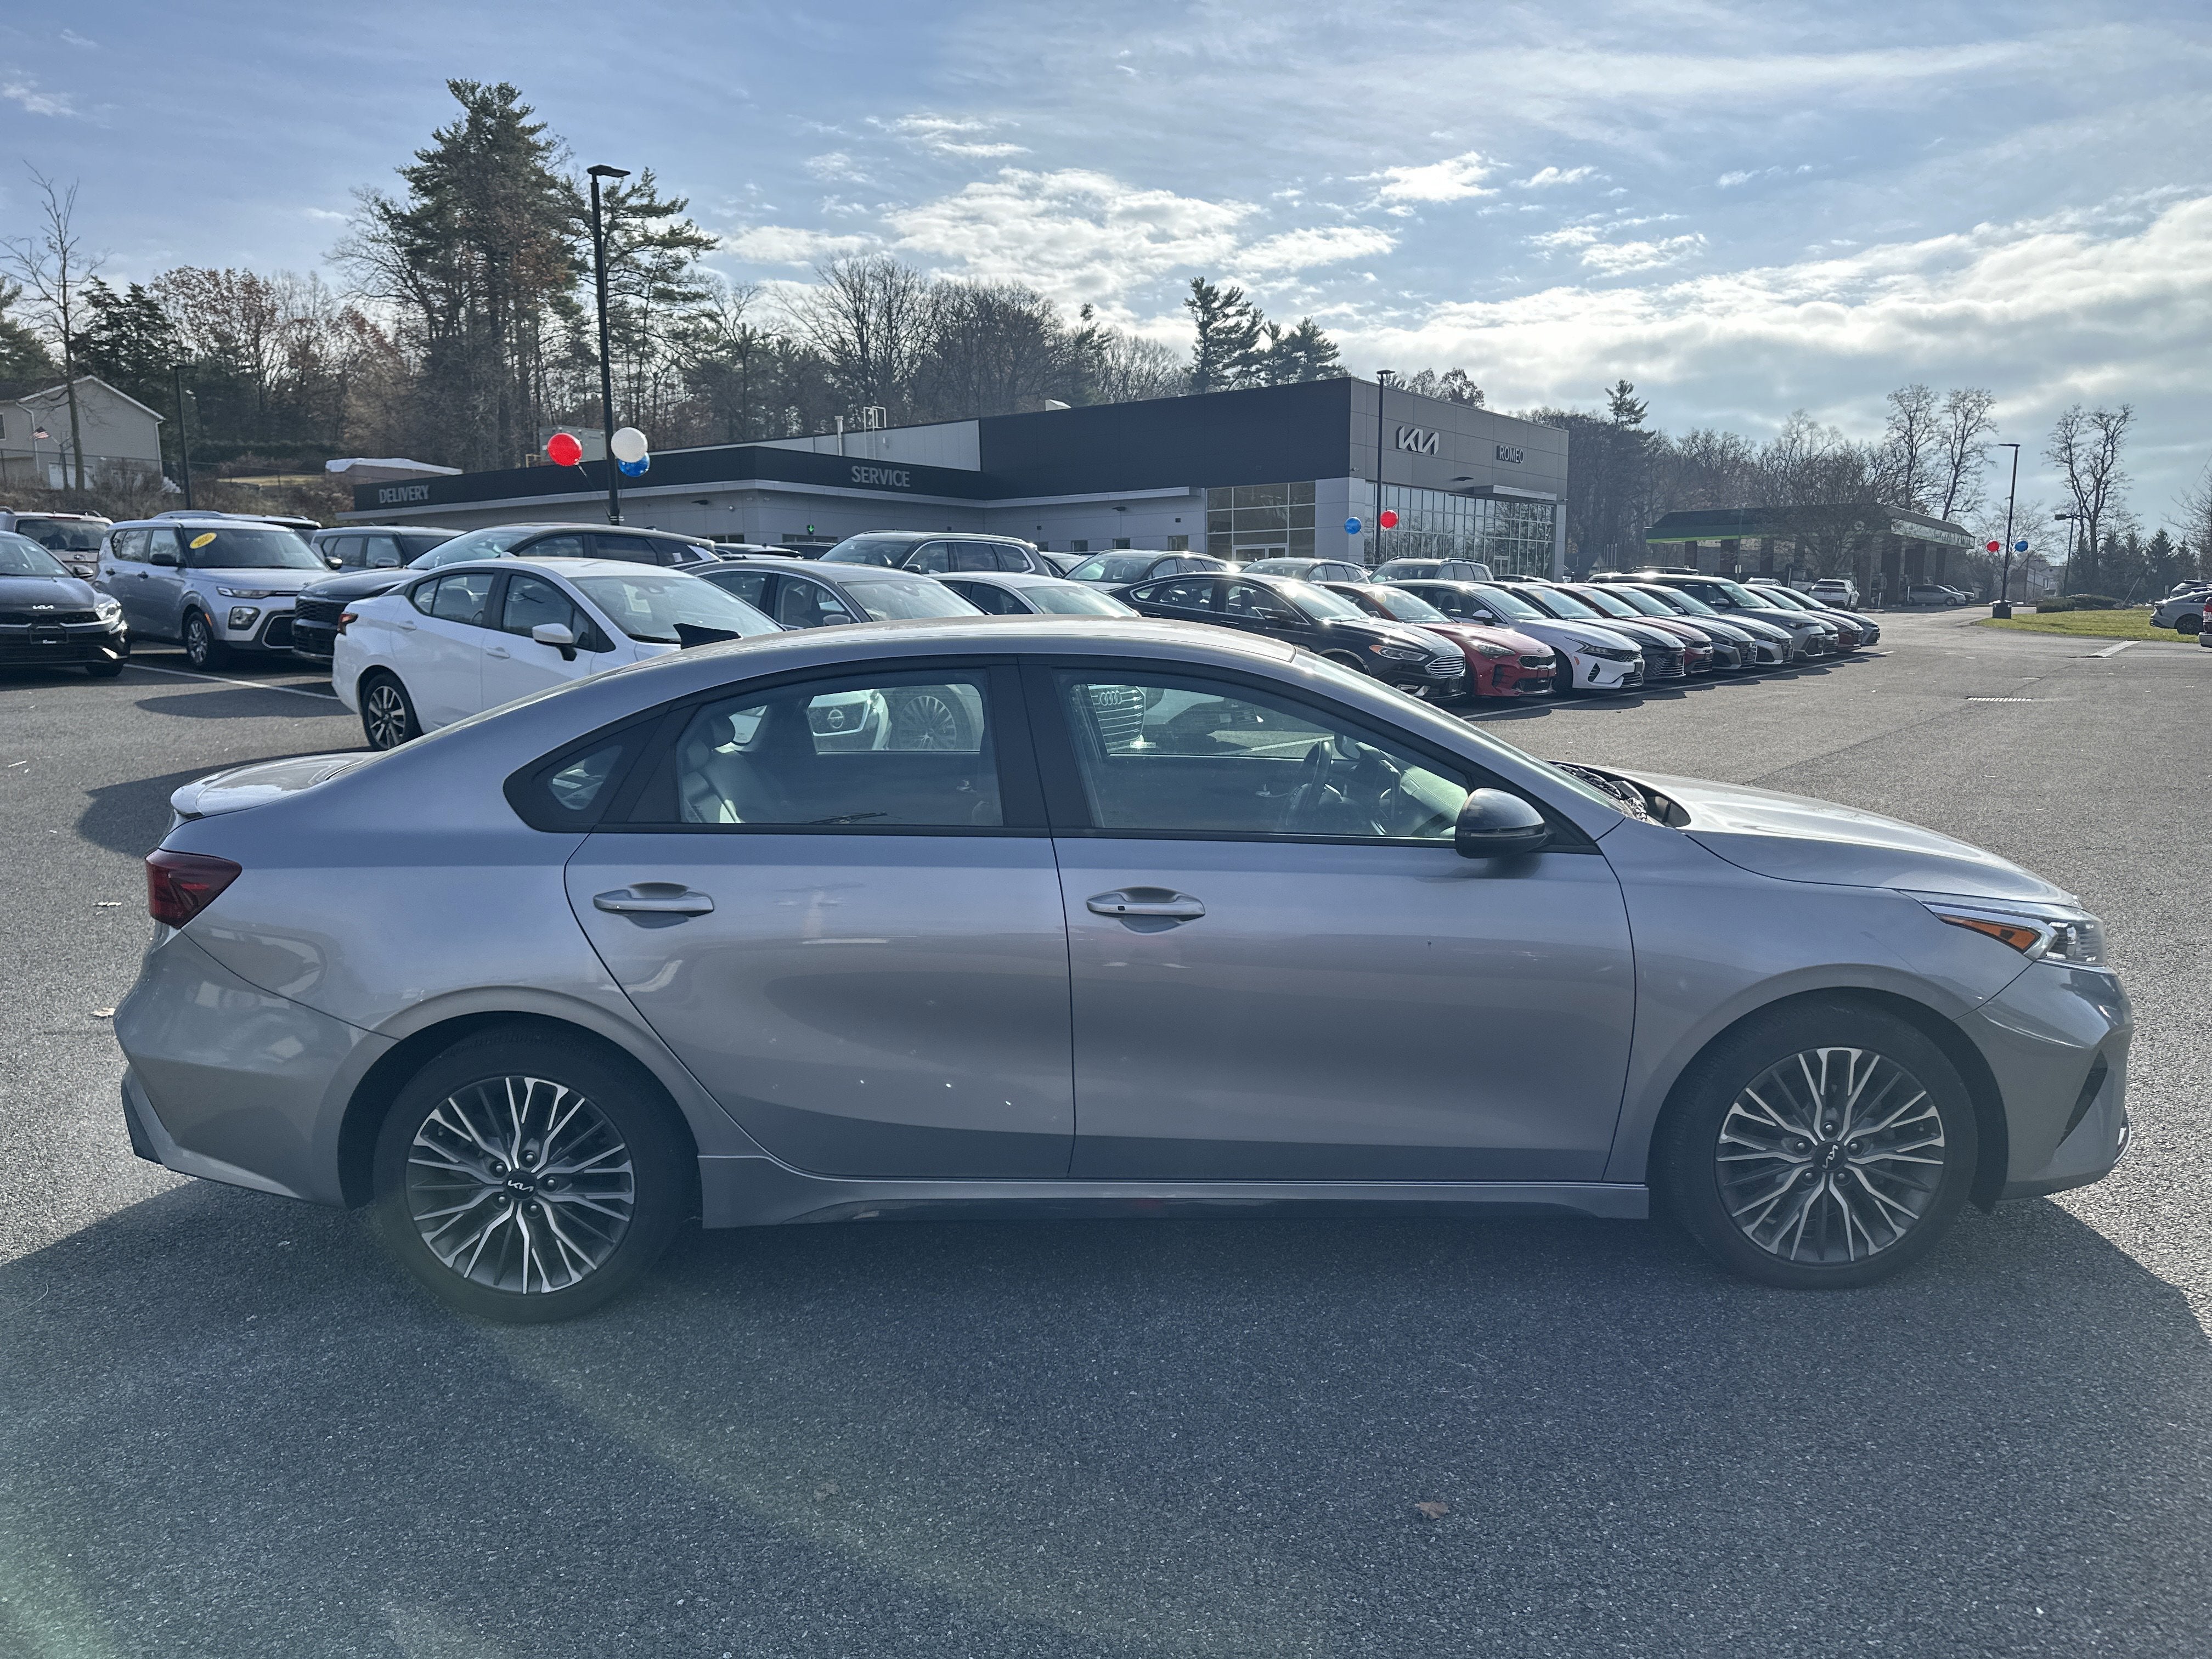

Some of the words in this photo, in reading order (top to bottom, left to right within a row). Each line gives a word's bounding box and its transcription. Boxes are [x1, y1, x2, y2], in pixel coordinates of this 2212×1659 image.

[1499, 445, 1524, 464] ROMEO
[851, 465, 911, 487] SERVICE
[379, 485, 429, 504] DELIVERY
